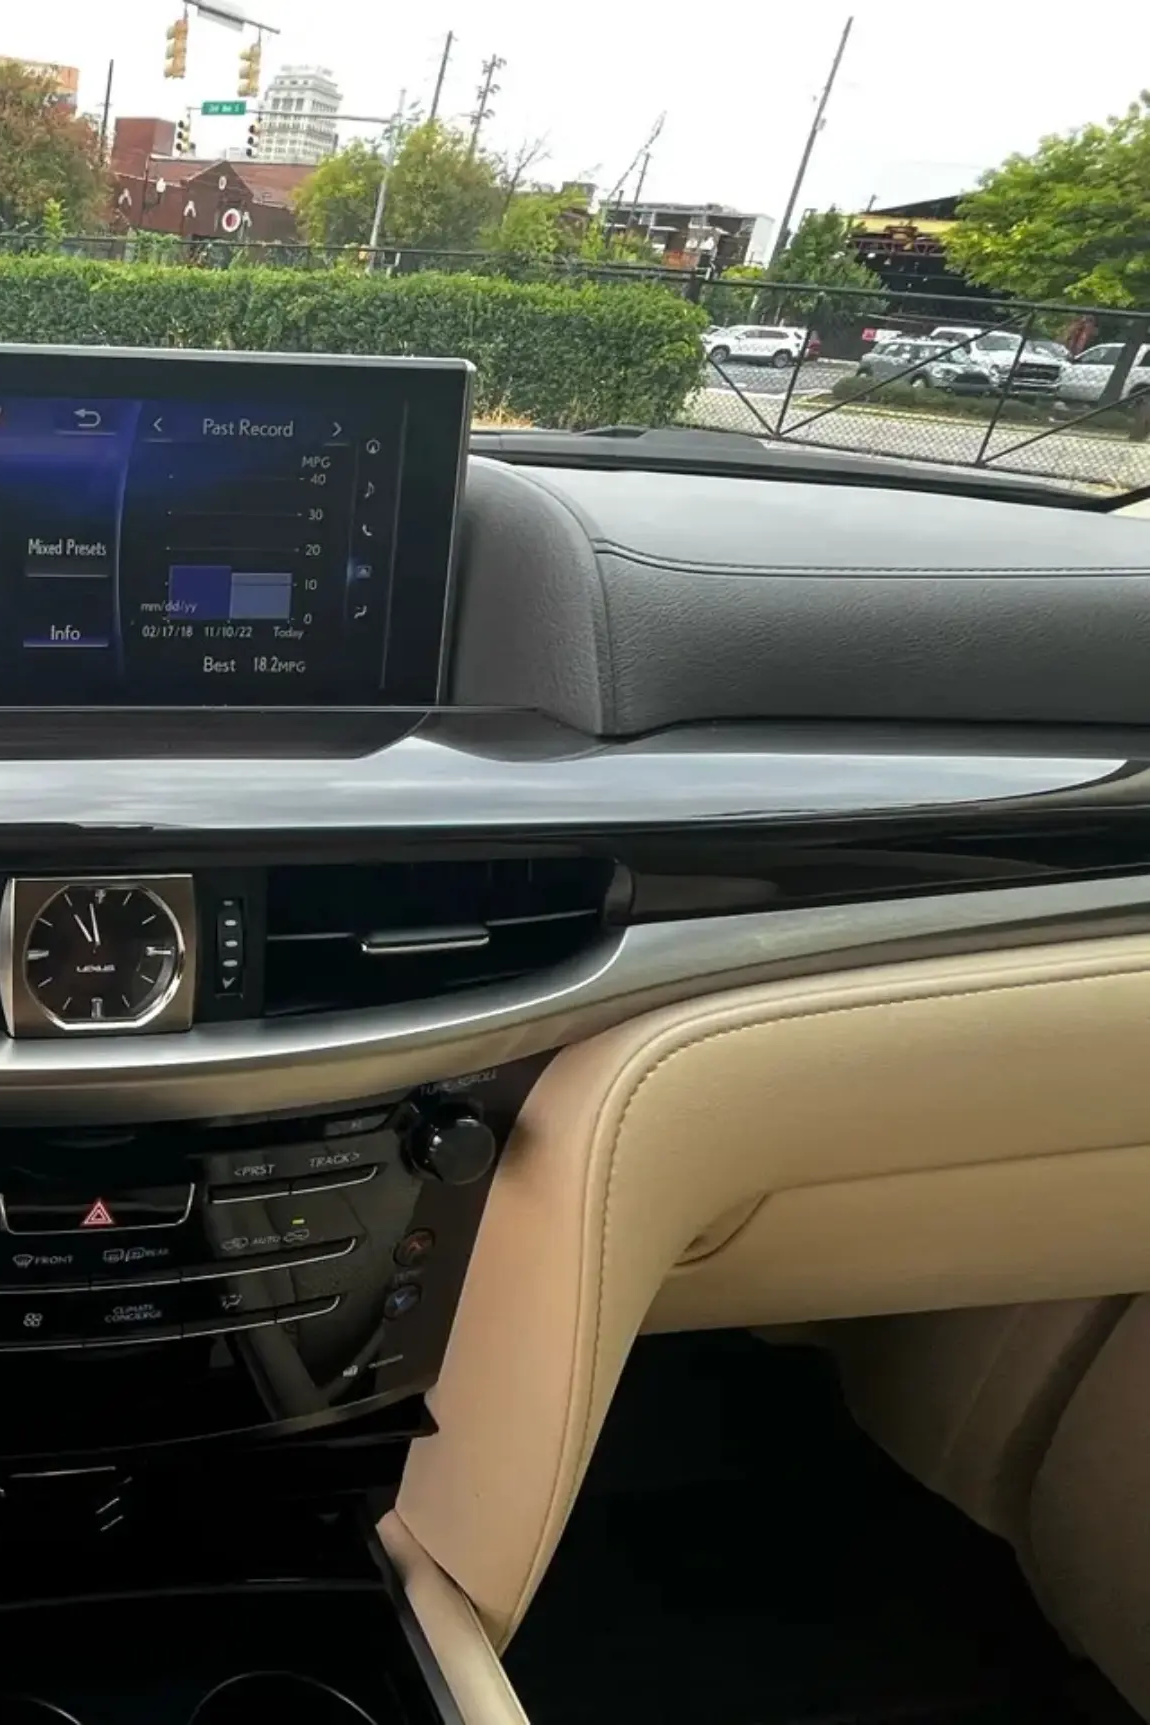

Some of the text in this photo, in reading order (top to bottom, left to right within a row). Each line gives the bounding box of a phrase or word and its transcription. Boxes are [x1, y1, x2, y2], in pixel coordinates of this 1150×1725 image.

[202, 418, 294, 438] Past Record
[301, 455, 331, 469] MPG
[310, 473, 326, 486] 40
[308, 508, 323, 521] 30
[28, 539, 107, 557] Mixed Presets
[305, 544, 321, 557] 20
[304, 579, 317, 591] 10
[141, 601, 197, 615] mm/dd/yy
[303, 612, 312, 625] 0
[50, 625, 81, 642] Info
[142, 626, 304, 640] 02/17/18 11/10/22 Today
[203, 657, 236, 673] Best
